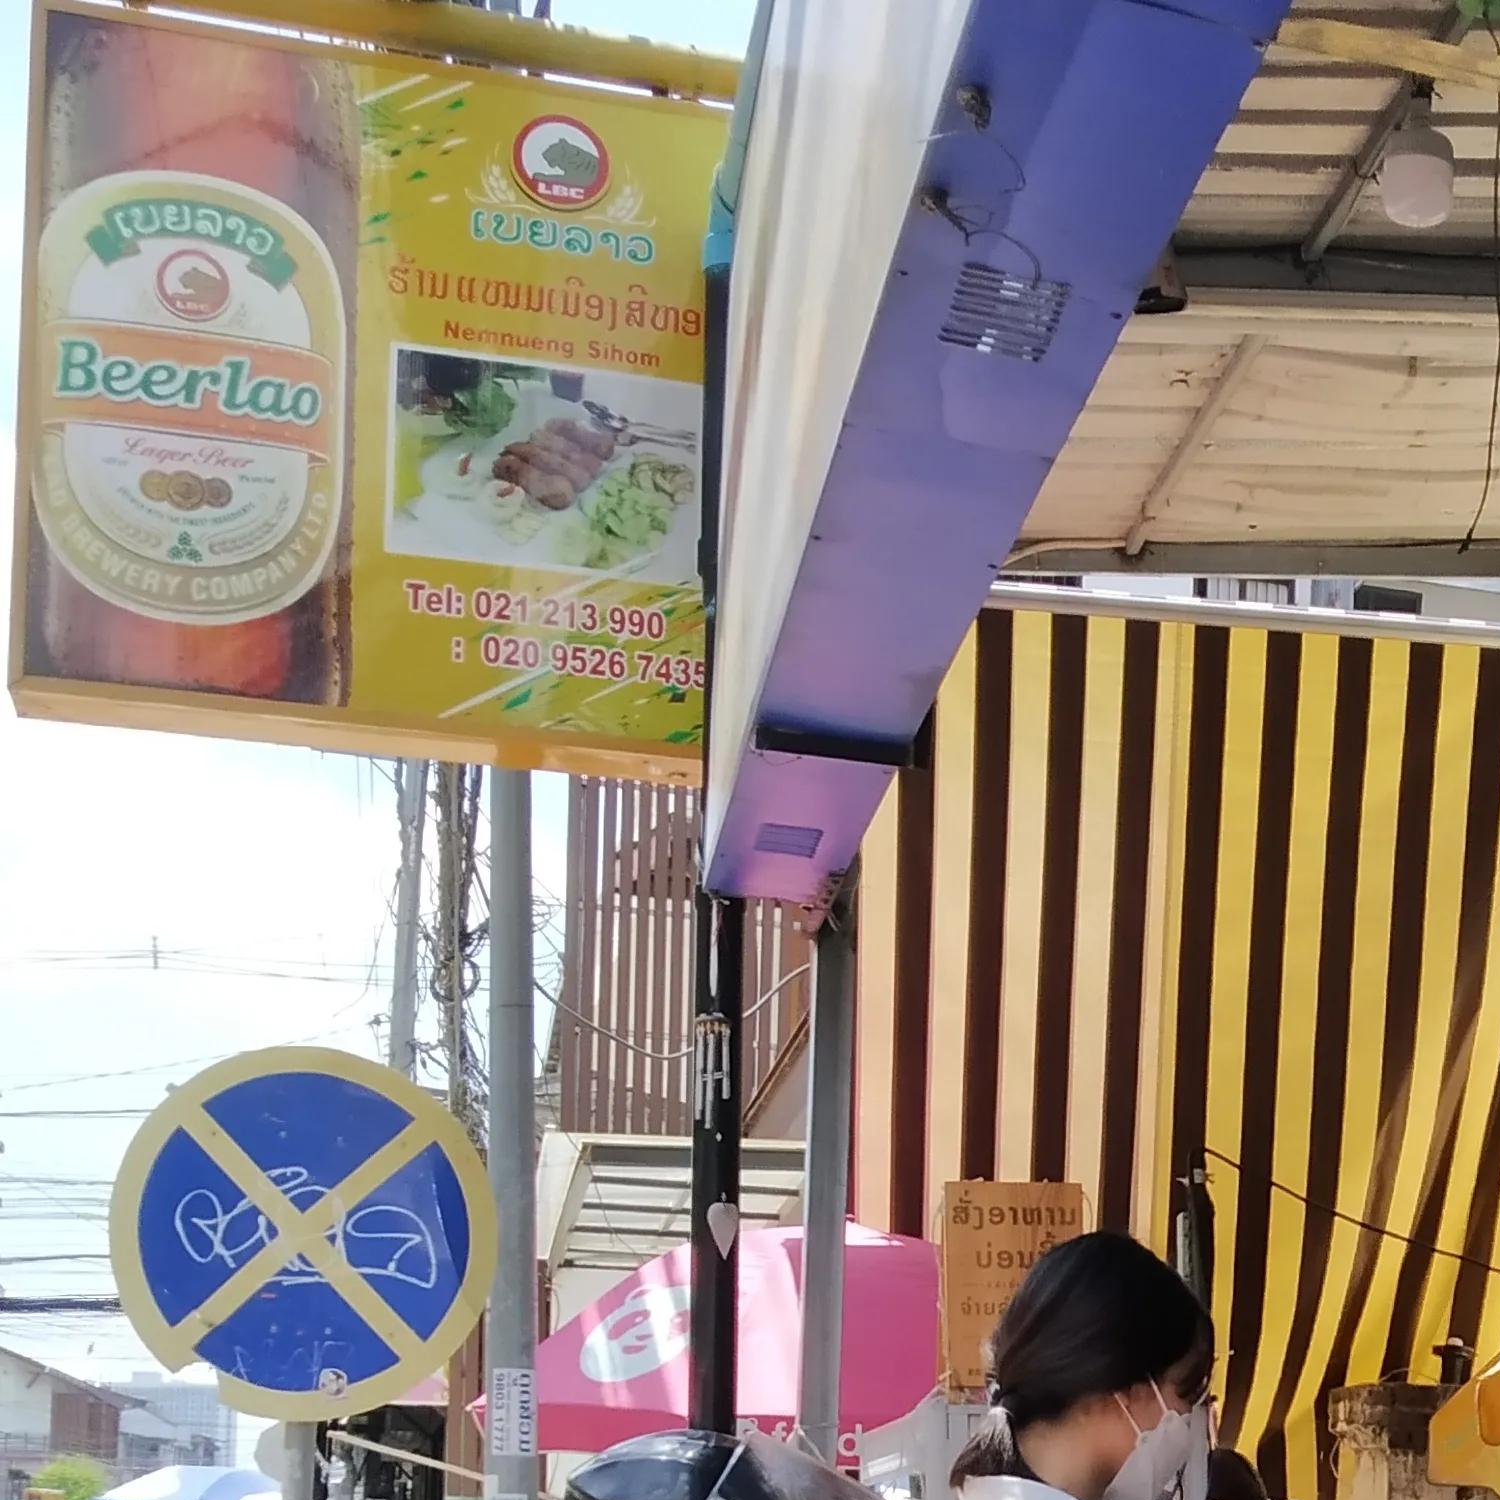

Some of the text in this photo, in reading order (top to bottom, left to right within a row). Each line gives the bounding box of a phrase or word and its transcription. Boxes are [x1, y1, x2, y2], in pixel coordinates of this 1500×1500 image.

[536, 181, 586, 199] LBC
[113, 203, 275, 256] ເບຍລາວ
[471, 208, 656, 264] ເບຍລາວ
[443, 319, 661, 368] Nemnueng Sihom
[55, 336, 321, 424] Beerlao
[124, 436, 192, 464] Lager
[193, 446, 256, 469] Beer
[61, 511, 183, 596] BREWERY
[190, 538, 309, 601] COMPANY
[405, 582, 665, 640] Tel: 021 213 990
[482, 635, 540, 669] 020
[551, 643, 626, 679] 9526
[635, 652, 705, 689] 7435
